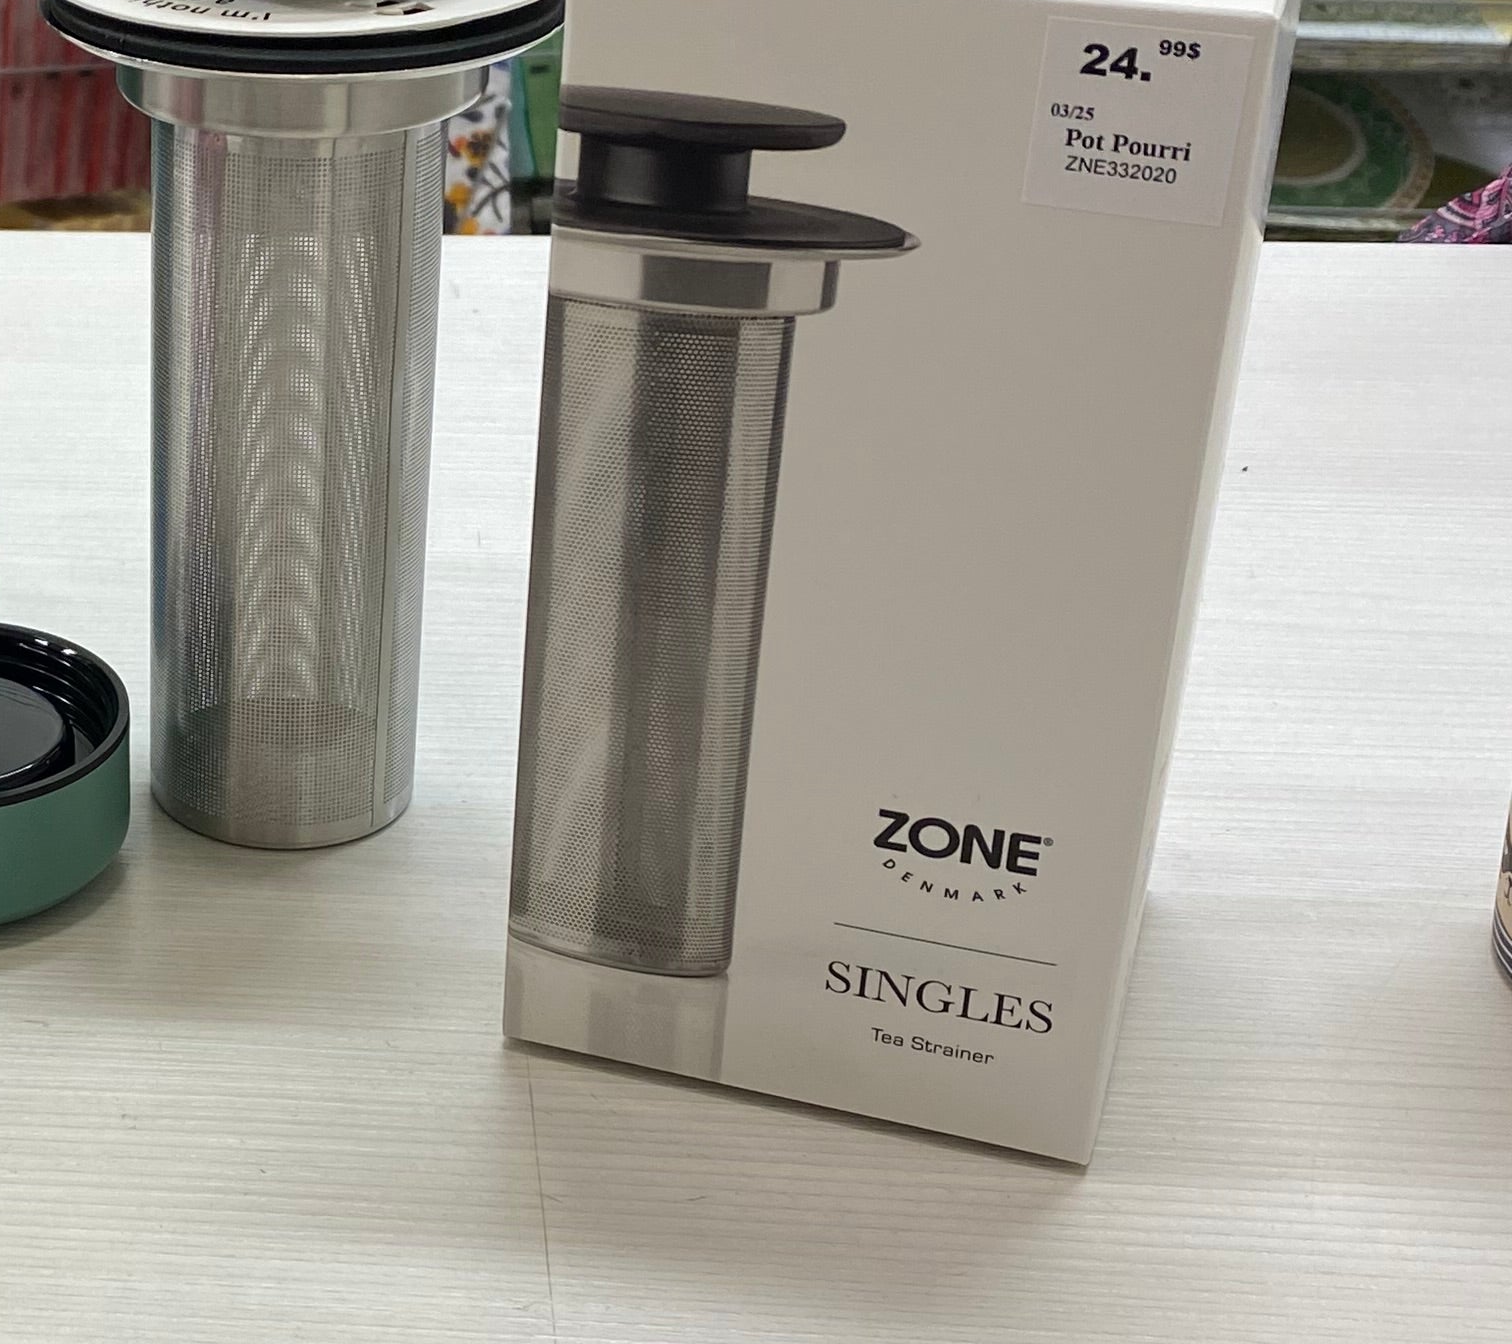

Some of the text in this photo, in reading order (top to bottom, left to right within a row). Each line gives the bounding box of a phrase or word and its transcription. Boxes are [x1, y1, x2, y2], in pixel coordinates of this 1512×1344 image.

[1079, 39, 1202, 82] 24. 99$
[1050, 103, 1096, 122] 03/25
[1064, 127, 1192, 162] Pot Pourri
[1064, 154, 1178, 185] ZNE332020
[881, 857, 1028, 903] DENMARK
[824, 960, 1054, 1034] SINGLES
[871, 1027, 996, 1065] Tea Strainer
